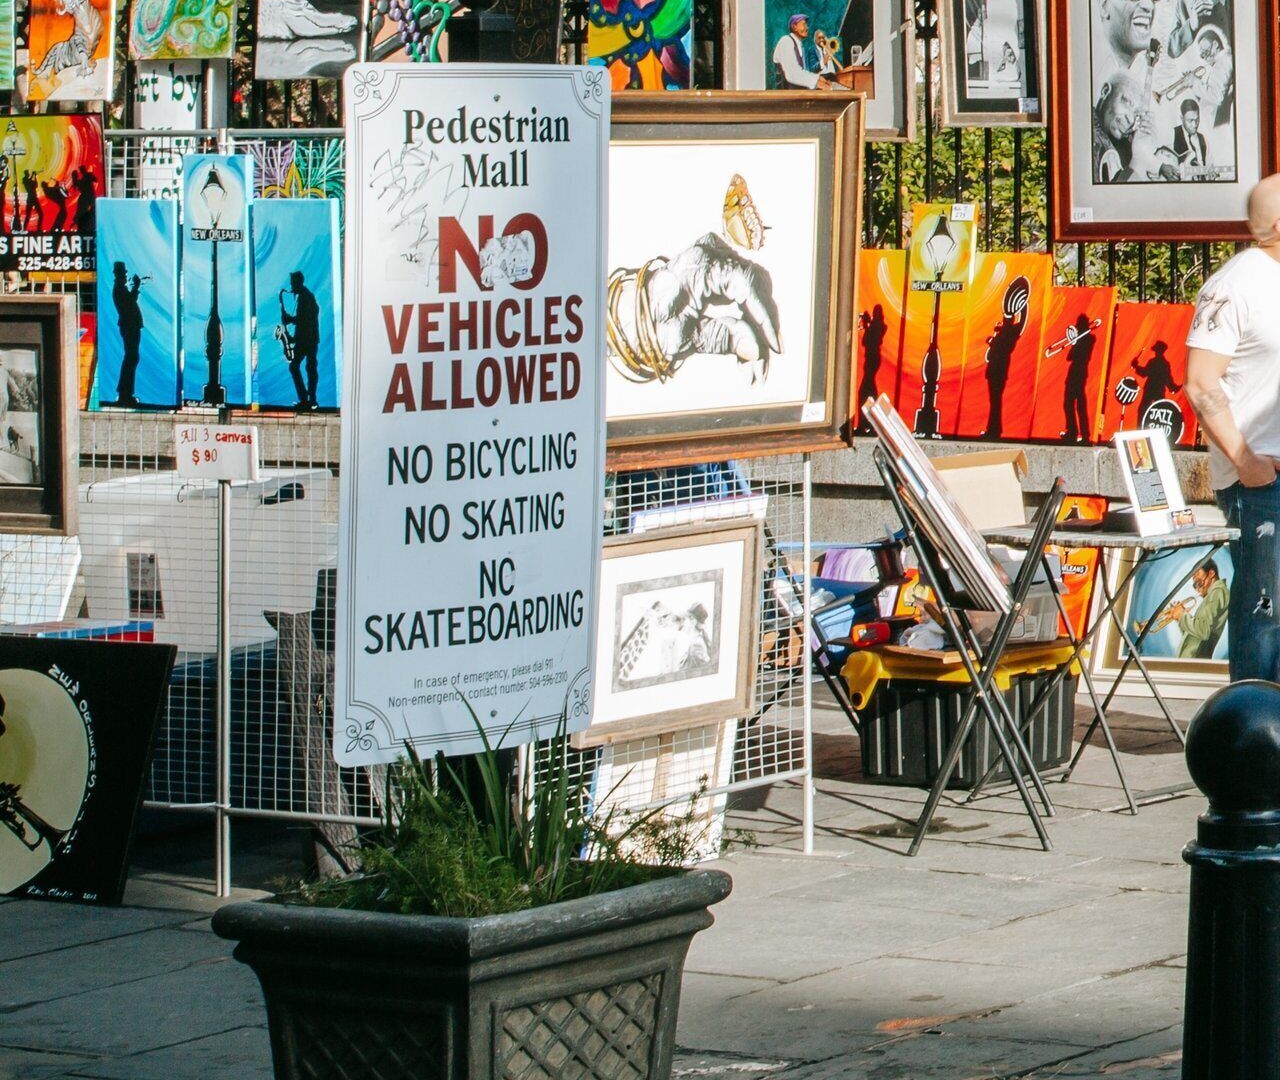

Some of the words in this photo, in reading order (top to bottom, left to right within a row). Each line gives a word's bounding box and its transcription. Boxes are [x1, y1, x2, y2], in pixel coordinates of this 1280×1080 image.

[168, 63, 202, 112] by
[403, 106, 571, 144] Pedestrian
[461, 150, 529, 188] Mall
[13, 236, 54, 255] FINE
[57, 236, 97, 255] ART
[209, 229, 240, 240] ORLEANS
[438, 213, 549, 294] NO
[913, 281, 927, 291] NEW
[931, 281, 960, 291] ORLEANS
[381, 295, 584, 355] VEHICLES
[382, 352, 581, 414] ALLOWED
[181, 427, 197, 444] All
[203, 427, 210, 442] 3
[215, 432, 253, 445] canvas
[1150, 408, 1173, 426] JAZZ
[388, 444, 433, 486] NO
[446, 431, 578, 482] BICYCLING
[404, 503, 450, 545] NO
[462, 491, 565, 540] SKATING
[364, 589, 584, 655] SKATEBOARDING
[49, 664, 80, 698] NEW
[414, 678, 423, 689] In
[426, 677, 447, 688] case
[451, 672, 460, 685] of
[463, 668, 510, 685] emergency,
[512, 664, 531, 679] please
[532, 660, 543, 673] dial
[544, 658, 554, 670] 911
[388, 689, 465, 708] Non-emergency
[468, 687, 498, 700] contact
[79, 700, 97, 789] ORLEANS
